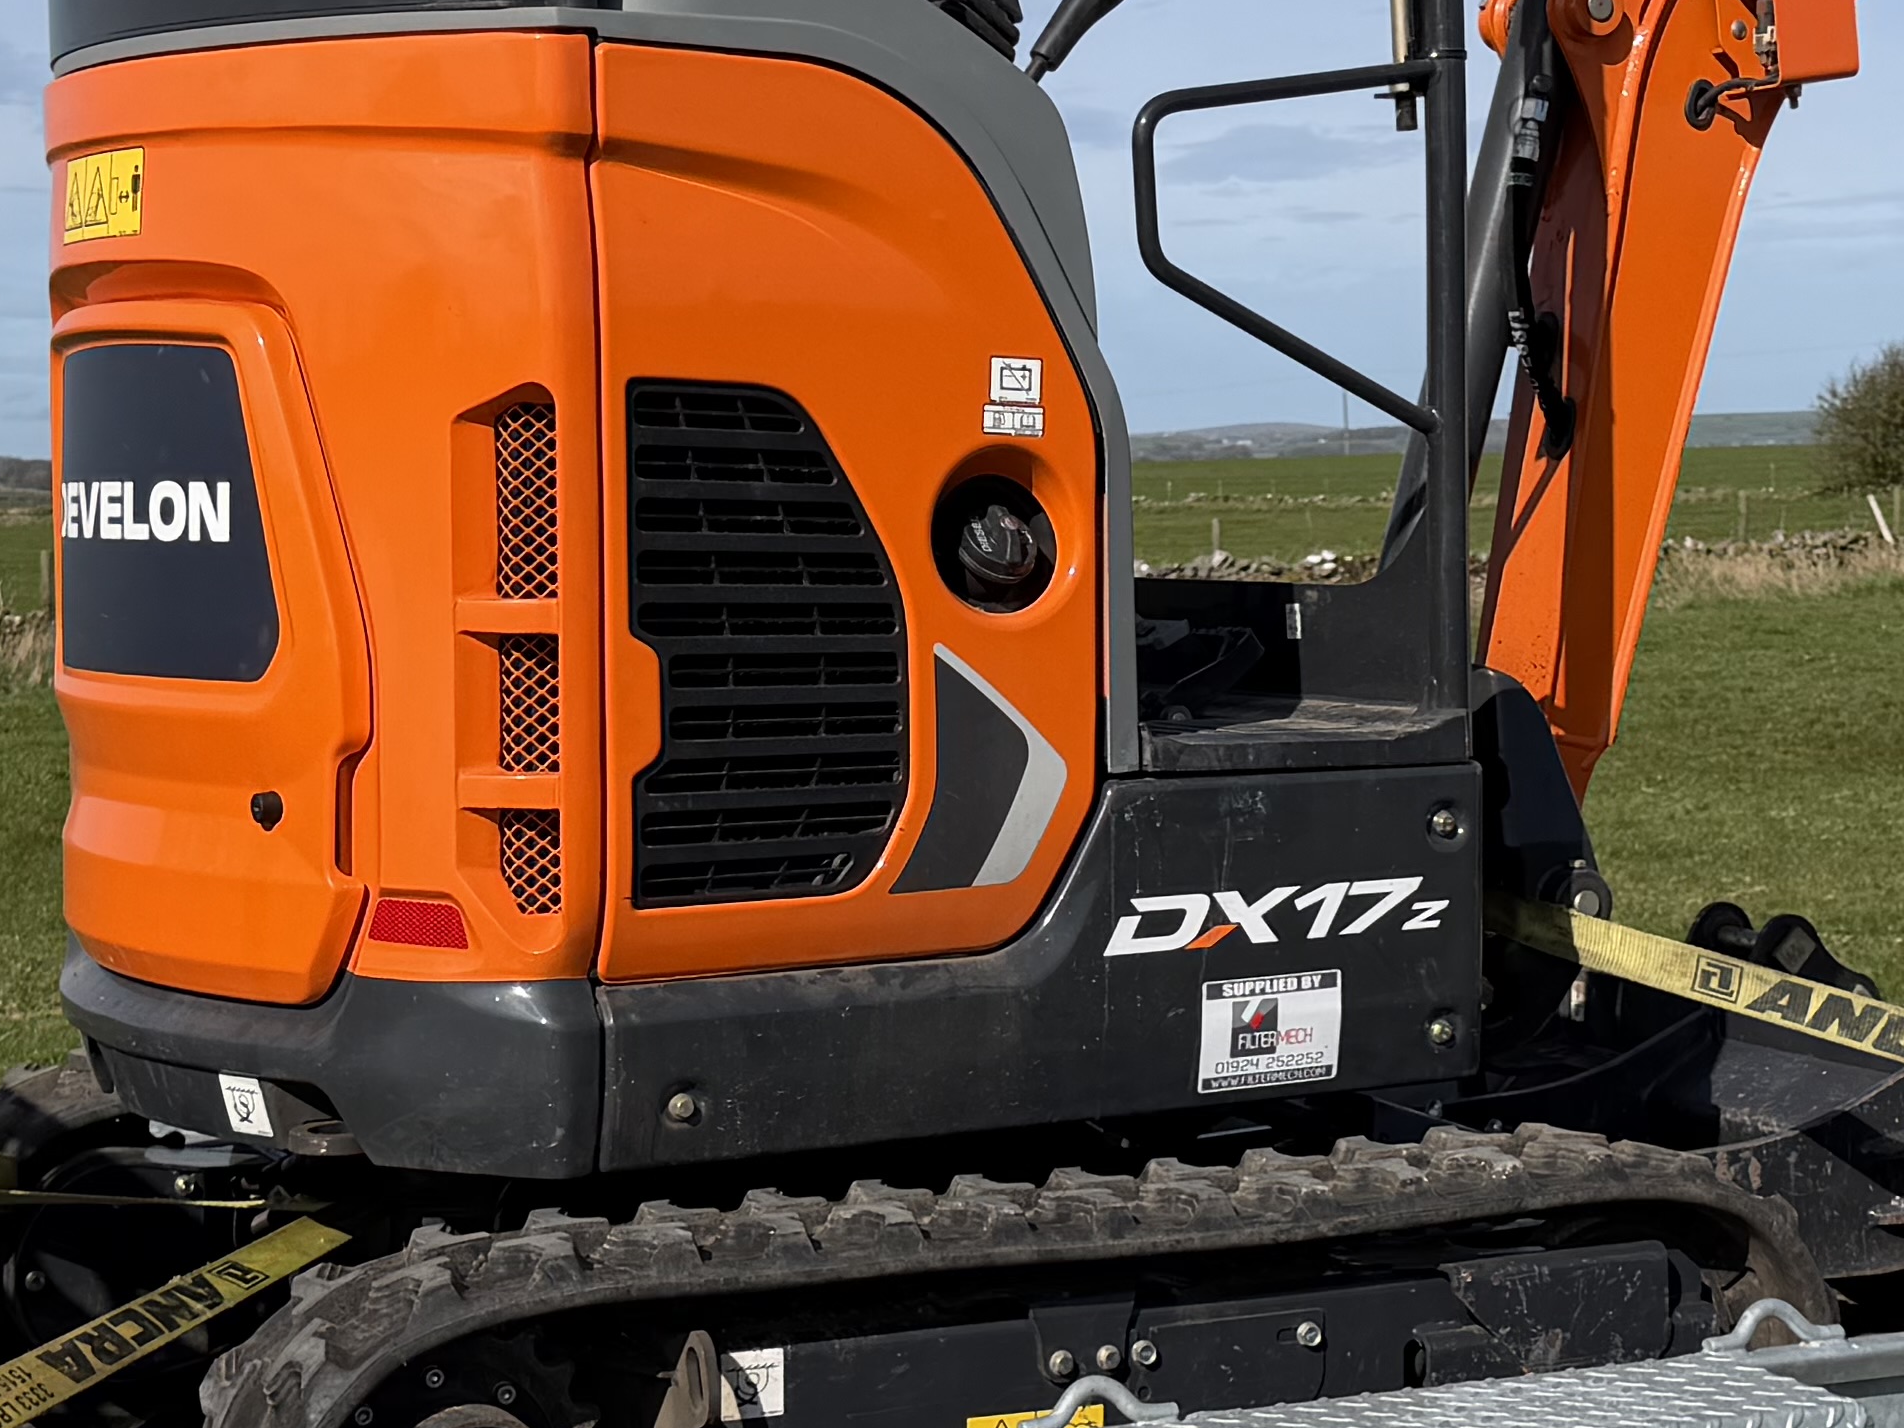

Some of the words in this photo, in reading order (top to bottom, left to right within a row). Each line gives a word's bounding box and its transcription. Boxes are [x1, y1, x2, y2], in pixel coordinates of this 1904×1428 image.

[1222, 977, 1297, 997] SUPPLIED
[1301, 974, 1322, 989] BY
[1215, 1058, 1260, 1074] 01924
[1265, 1051, 1324, 1069] 252252
[36, 1273, 224, 1384] ANCRA
